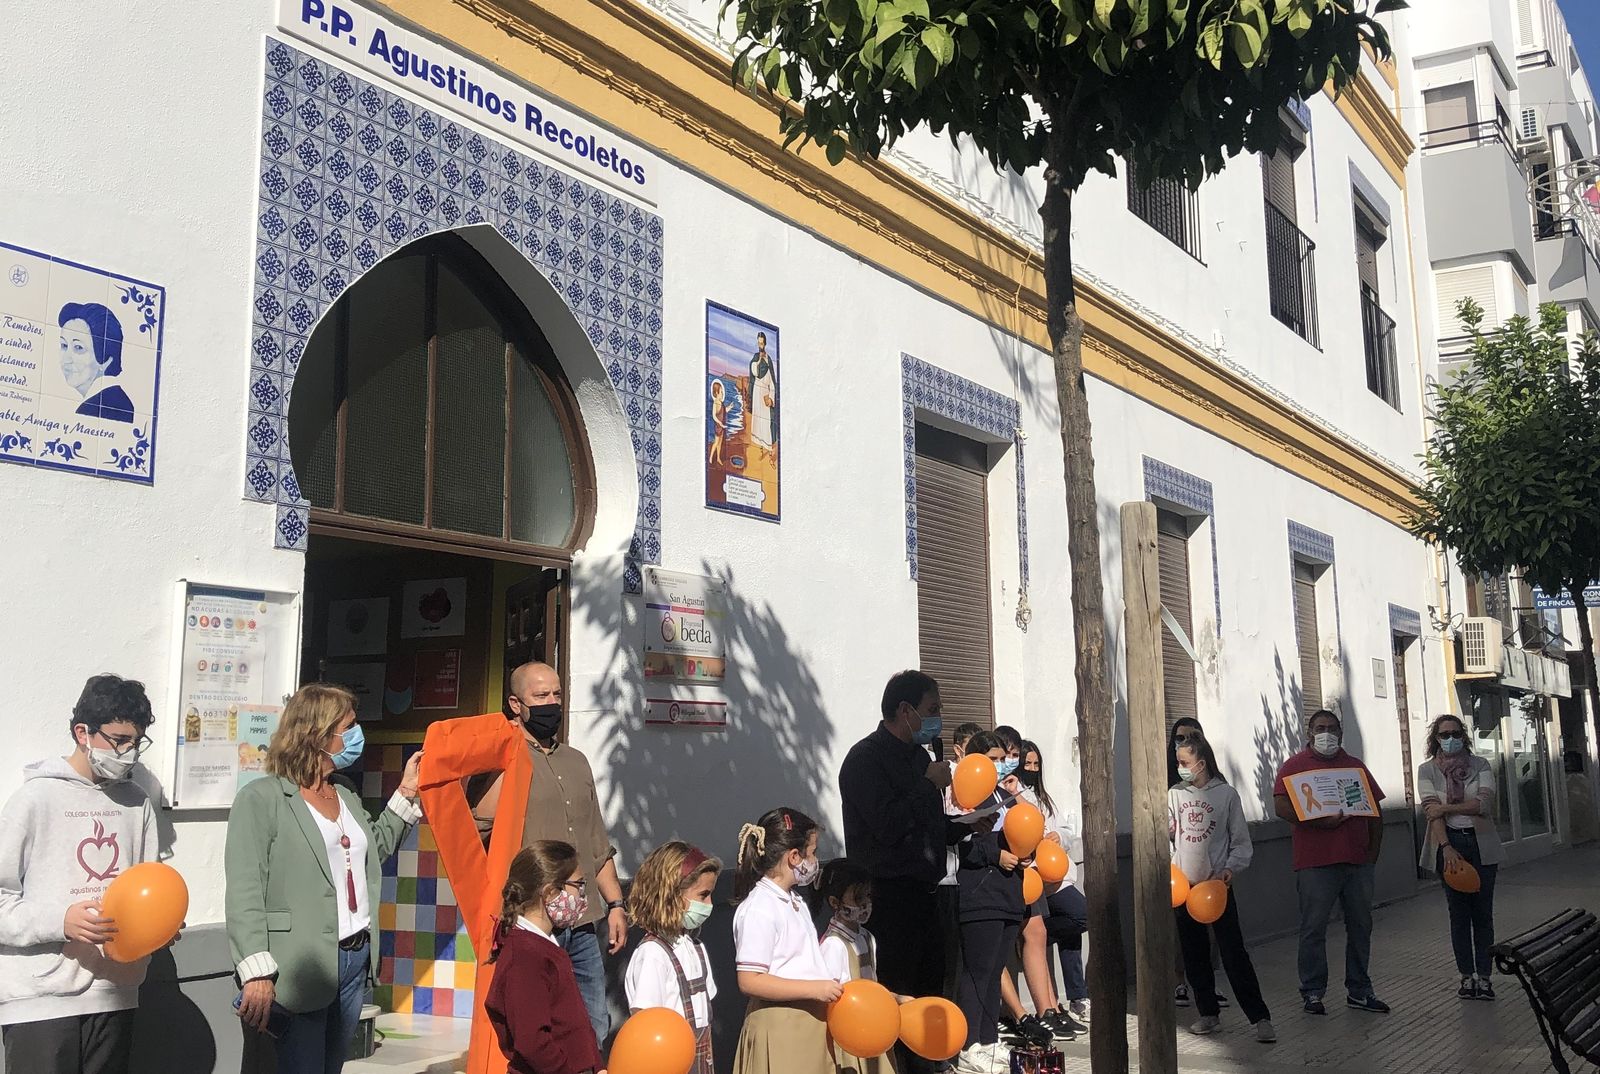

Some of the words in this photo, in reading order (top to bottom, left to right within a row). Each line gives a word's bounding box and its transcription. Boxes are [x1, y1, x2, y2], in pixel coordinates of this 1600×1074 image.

[301, 0, 357, 46] P.P.
[368, 28, 516, 123] Agustinos
[525, 102, 646, 186] Recoletos
[3, 315, 44, 336] Remedios,
[5, 337, 33, 352] ciudad,
[21, 413, 60, 431] Amiga
[63, 424, 70, 434] y
[69, 422, 115, 439] Maestra
[669, 592, 680, 603] San
[65, 810, 89, 818] COLEGIO
[1179, 800, 1214, 814] COLEGIO
[69, 885, 101, 896] agustinos
